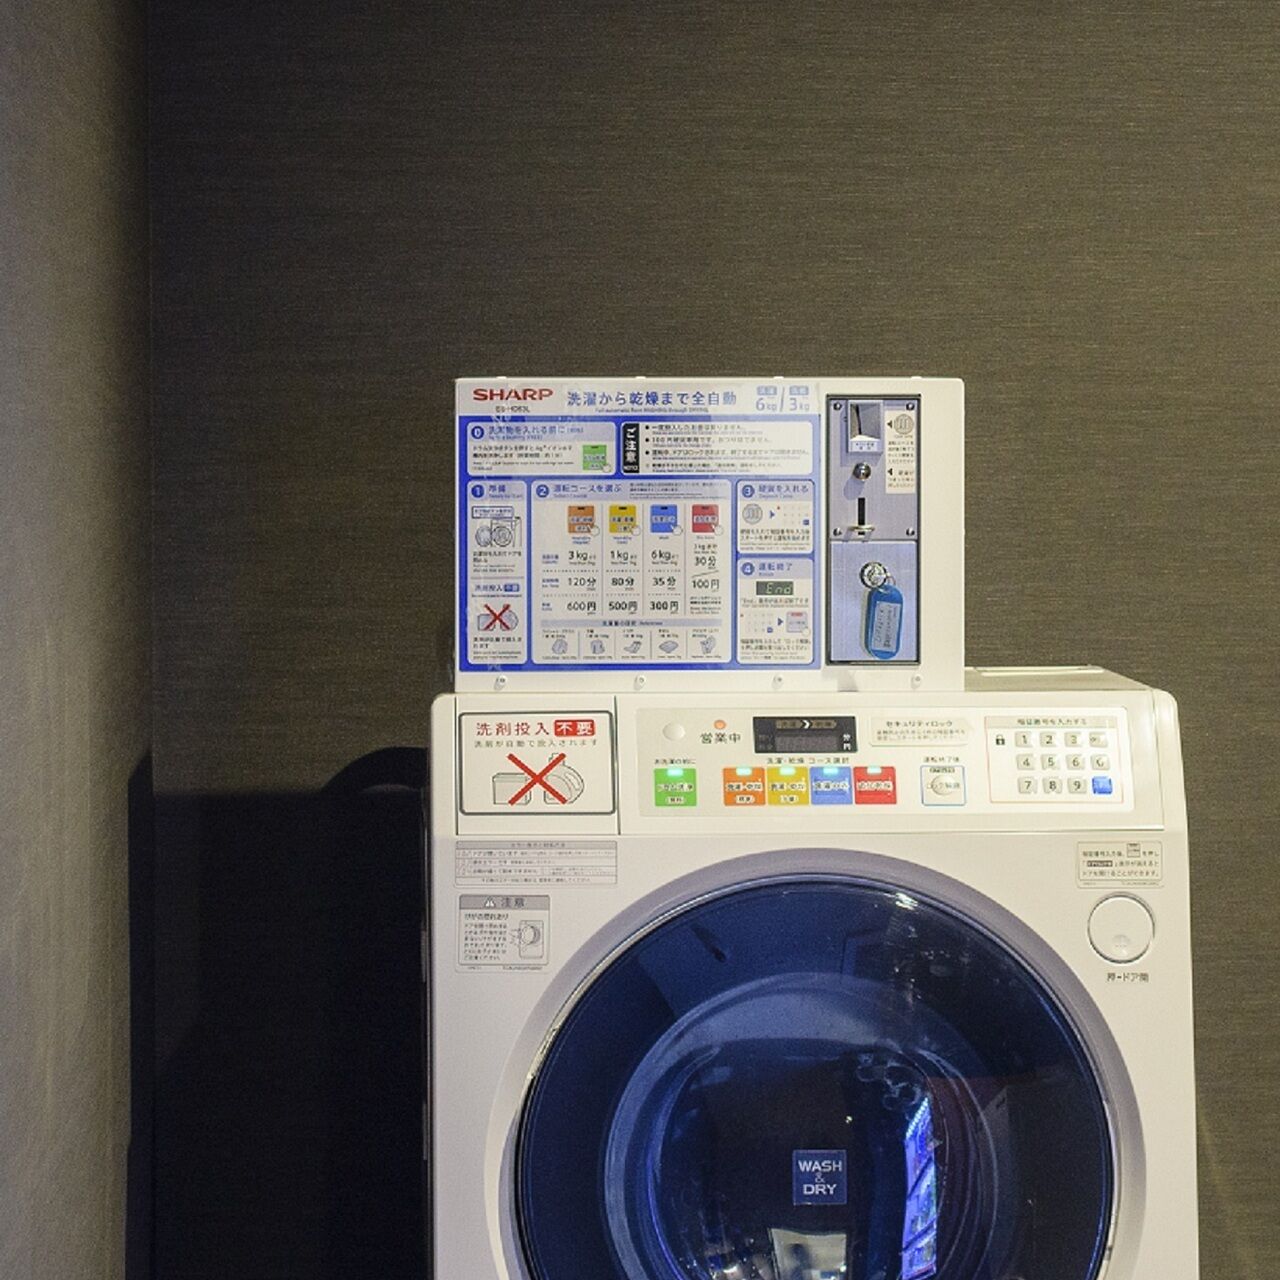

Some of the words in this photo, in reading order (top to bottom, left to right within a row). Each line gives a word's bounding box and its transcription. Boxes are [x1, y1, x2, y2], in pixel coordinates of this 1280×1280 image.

[473, 388, 553, 401] SHARP
[567, 391, 737, 406] 洗濯から乾燥まで全自動
[758, 562, 792, 571] 運転終了
[567, 577, 597, 587] 120分
[611, 577, 635, 587] 80分
[652, 576, 676, 586] 35分
[691, 579, 720, 589] 100円
[765, 582, 792, 594] End
[566, 601, 596, 611] 600円
[608, 600, 638, 611] 500円
[649, 600, 679, 611] 300円
[476, 721, 550, 737] 洗剤投入
[556, 720, 594, 736] 不要
[700, 732, 742, 745] 営業中
[1022, 735, 1028, 745] 1
[1046, 735, 1054, 745] 2
[1070, 735, 1077, 745] 3
[1022, 757, 1031, 768] 4
[1048, 757, 1055, 767] 5
[1072, 758, 1080, 768] 6
[1024, 780, 1031, 790] 7
[1049, 780, 1057, 791] 8
[1073, 780, 1081, 791] 9
[797, 1159, 843, 1172] WASH
[802, 1183, 837, 1195] DRY
